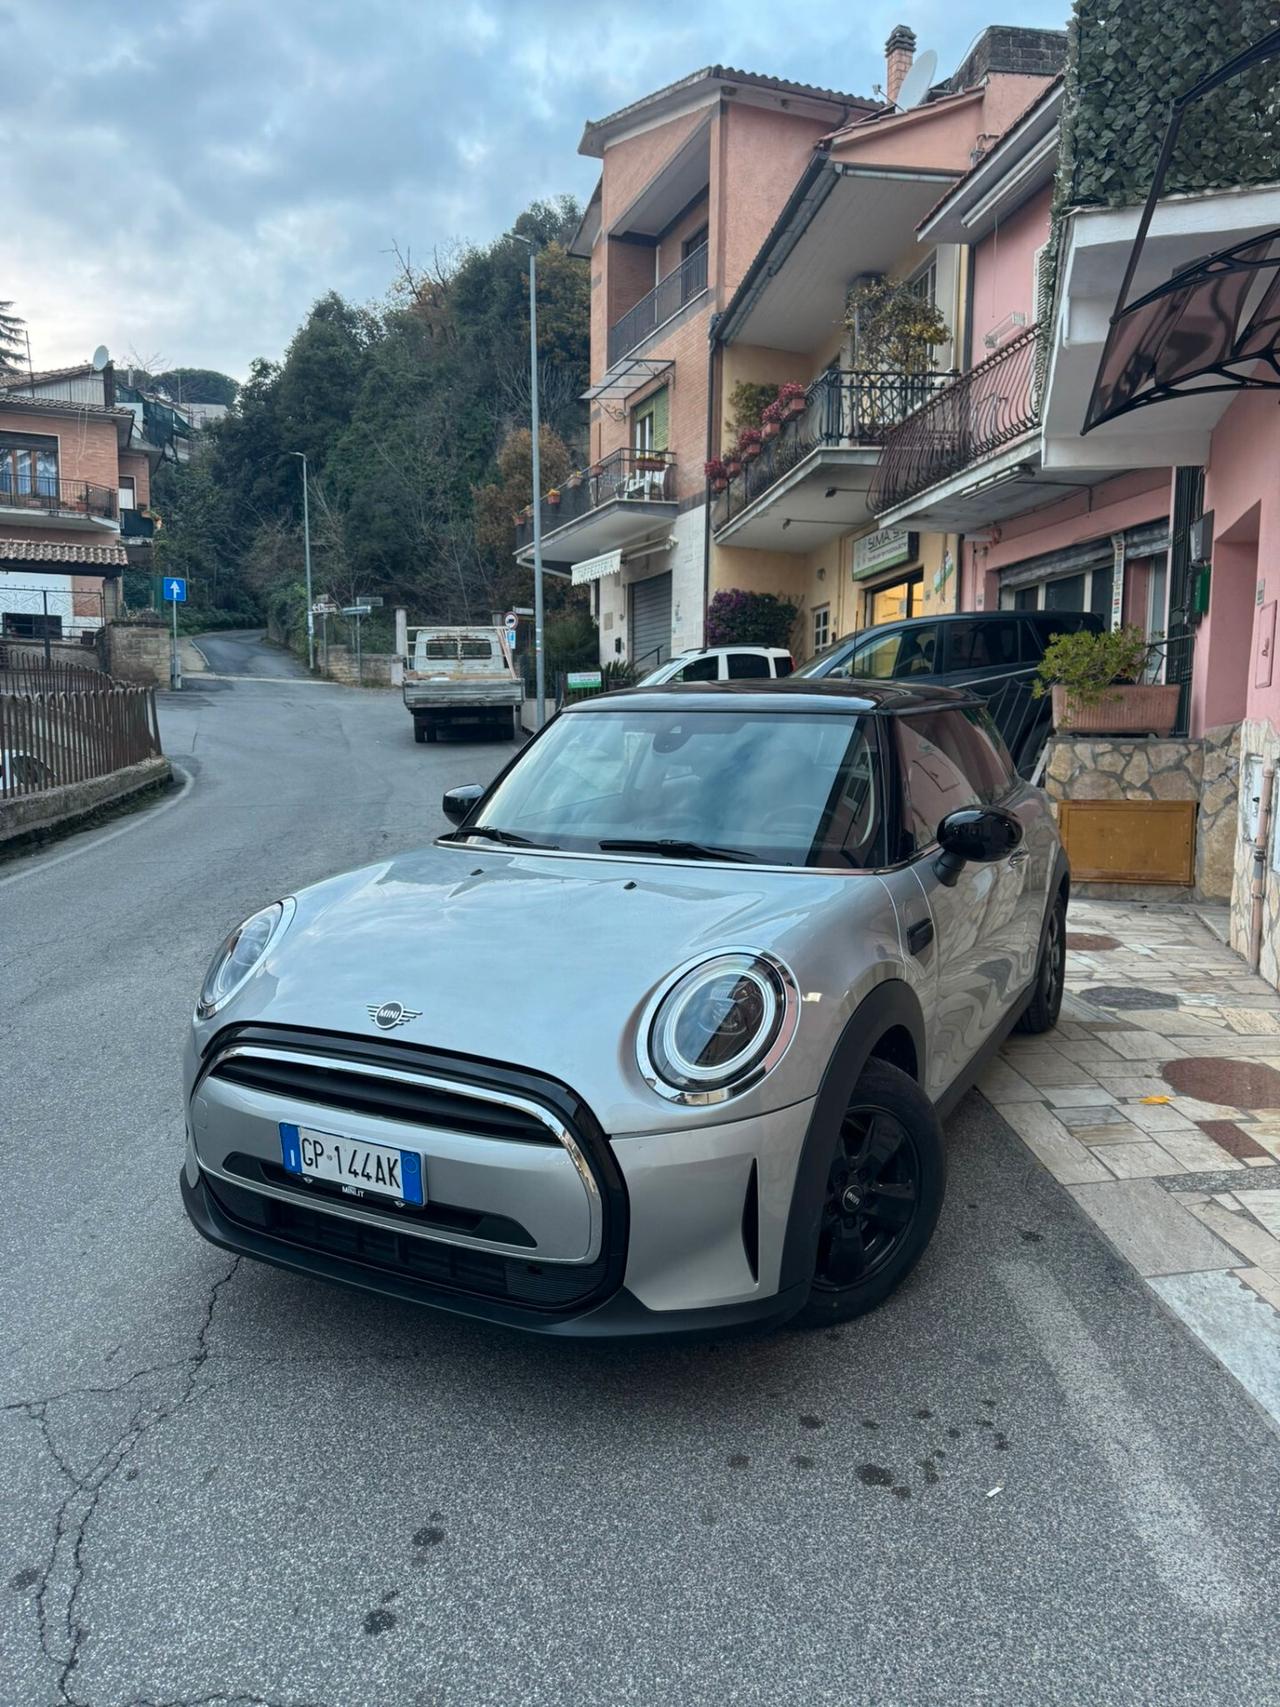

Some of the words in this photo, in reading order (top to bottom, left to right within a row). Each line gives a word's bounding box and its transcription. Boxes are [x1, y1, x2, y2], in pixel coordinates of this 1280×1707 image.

[379, 1009, 400, 1019] MINI
[301, 1137, 325, 1169] GP
[334, 1145, 401, 1189] 144AK
